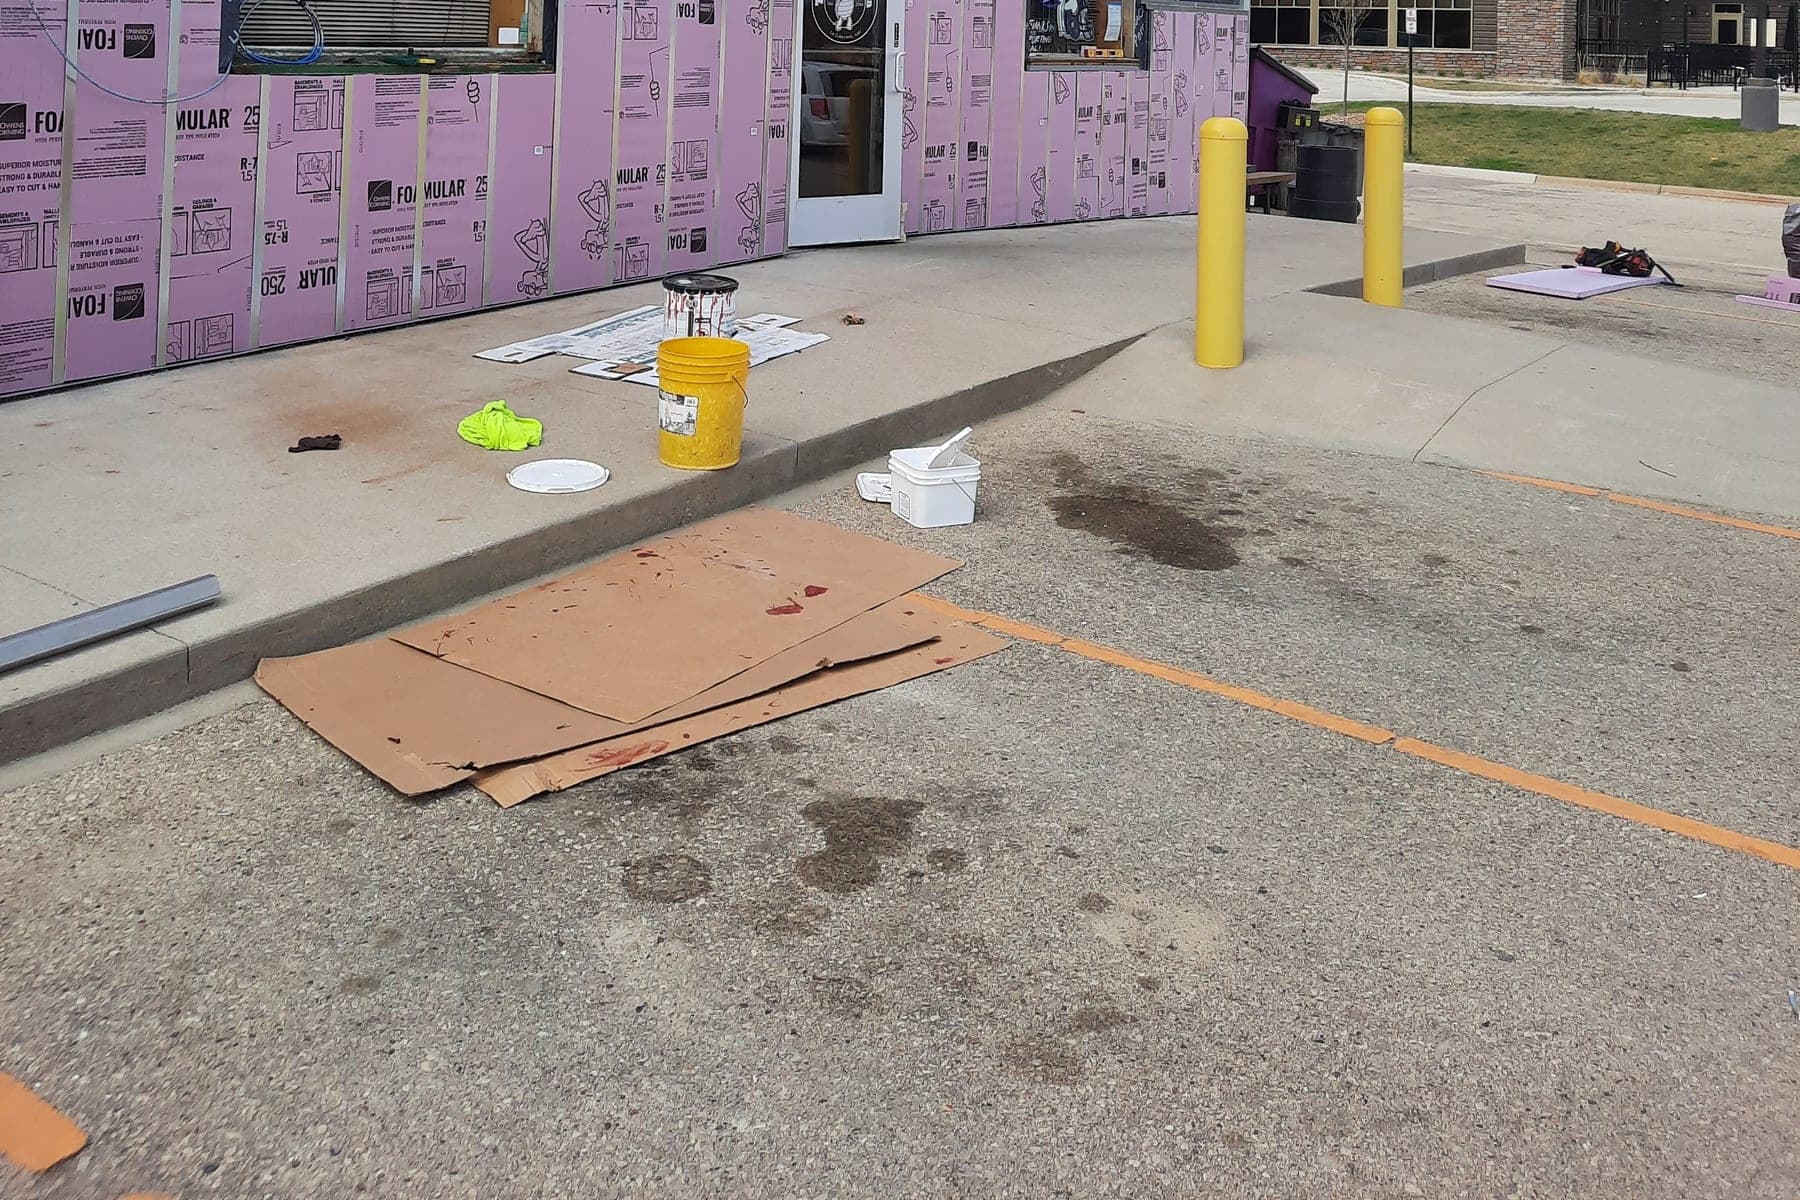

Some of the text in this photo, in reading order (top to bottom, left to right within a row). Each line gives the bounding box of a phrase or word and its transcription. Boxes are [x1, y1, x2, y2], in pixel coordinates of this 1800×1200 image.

[33, 171, 61, 179] DURABL
[27, 184, 40, 192] CUT
[100, 237, 113, 245] CUT
[124, 234, 140, 242] EASY
[264, 230, 288, 245] R-7.5
[70, 240, 94, 248] HANDL
[79, 249, 108, 258] DURABLE
[115, 246, 139, 254] STRONG
[371, 246, 383, 255] EASY
[75, 261, 108, 270] MOISTURE
[109, 257, 139, 266] SUPERIOR
[261, 266, 336, 297] 250 ULAR
